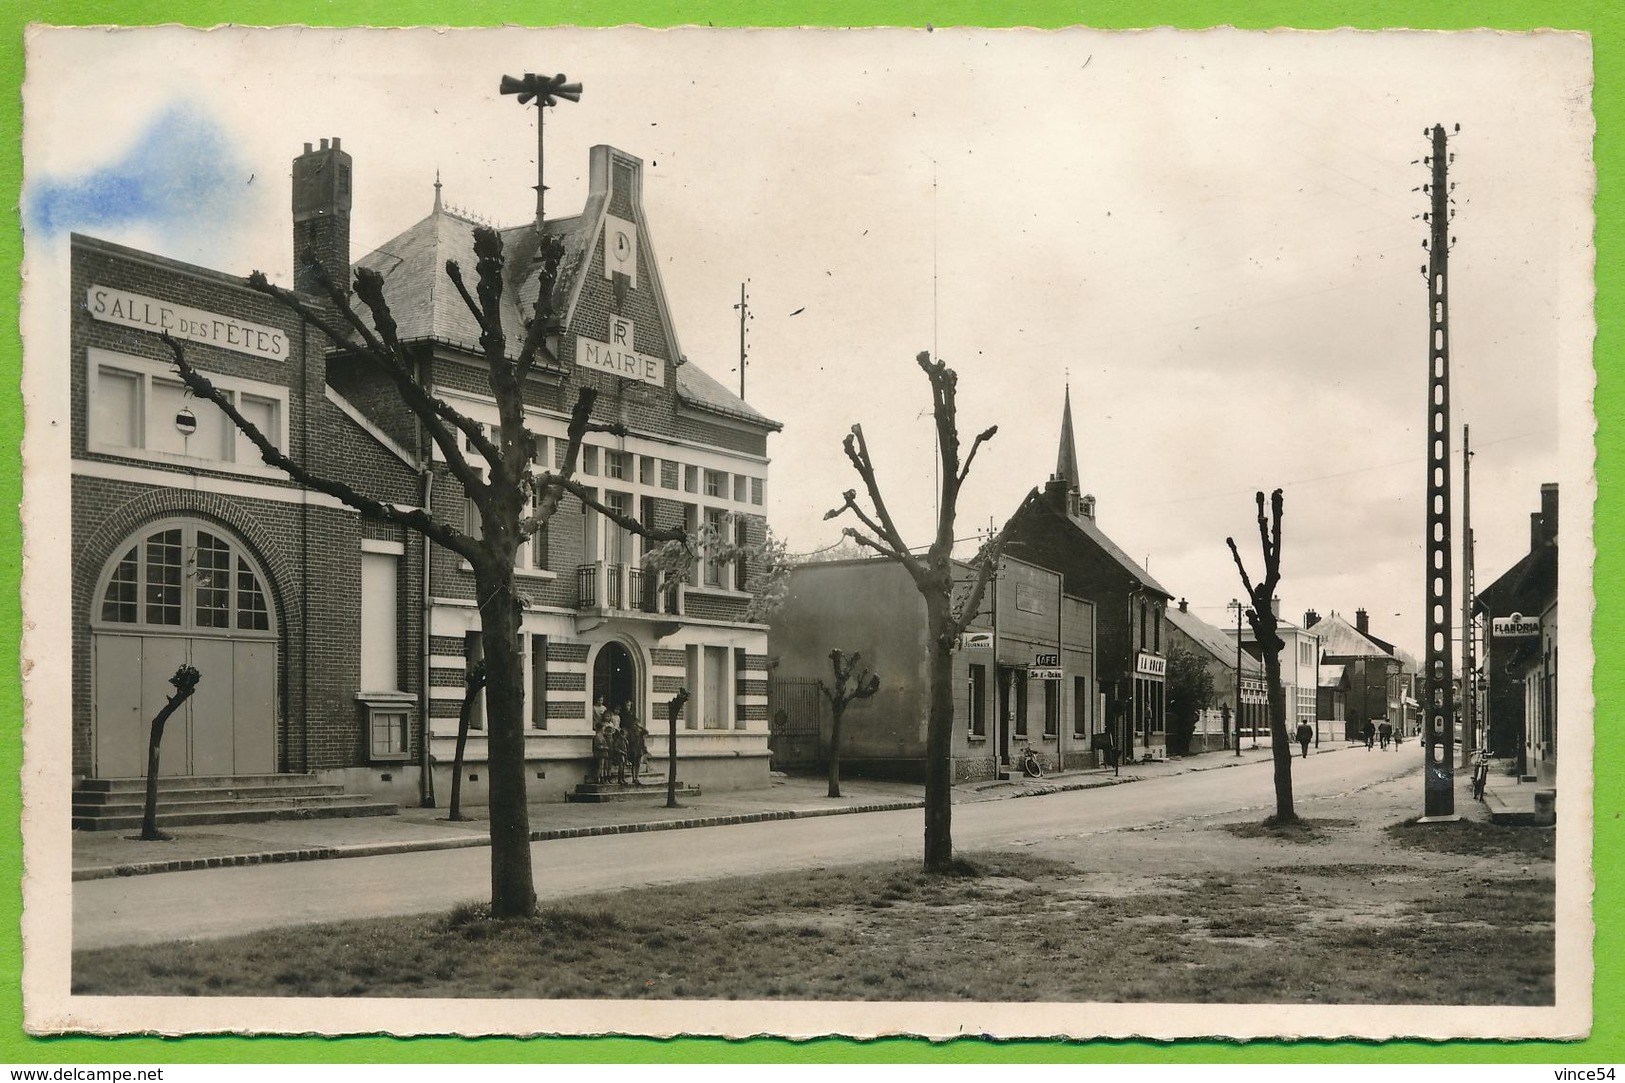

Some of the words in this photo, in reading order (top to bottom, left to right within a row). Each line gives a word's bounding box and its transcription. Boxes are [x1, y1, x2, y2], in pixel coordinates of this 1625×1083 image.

[94, 291, 174, 330] SALLE
[179, 318, 208, 338] DES
[212, 319, 282, 355] FÊTES
[585, 343, 657, 380] MAIRIE
[1494, 623, 1539, 632] FLANDRIA
